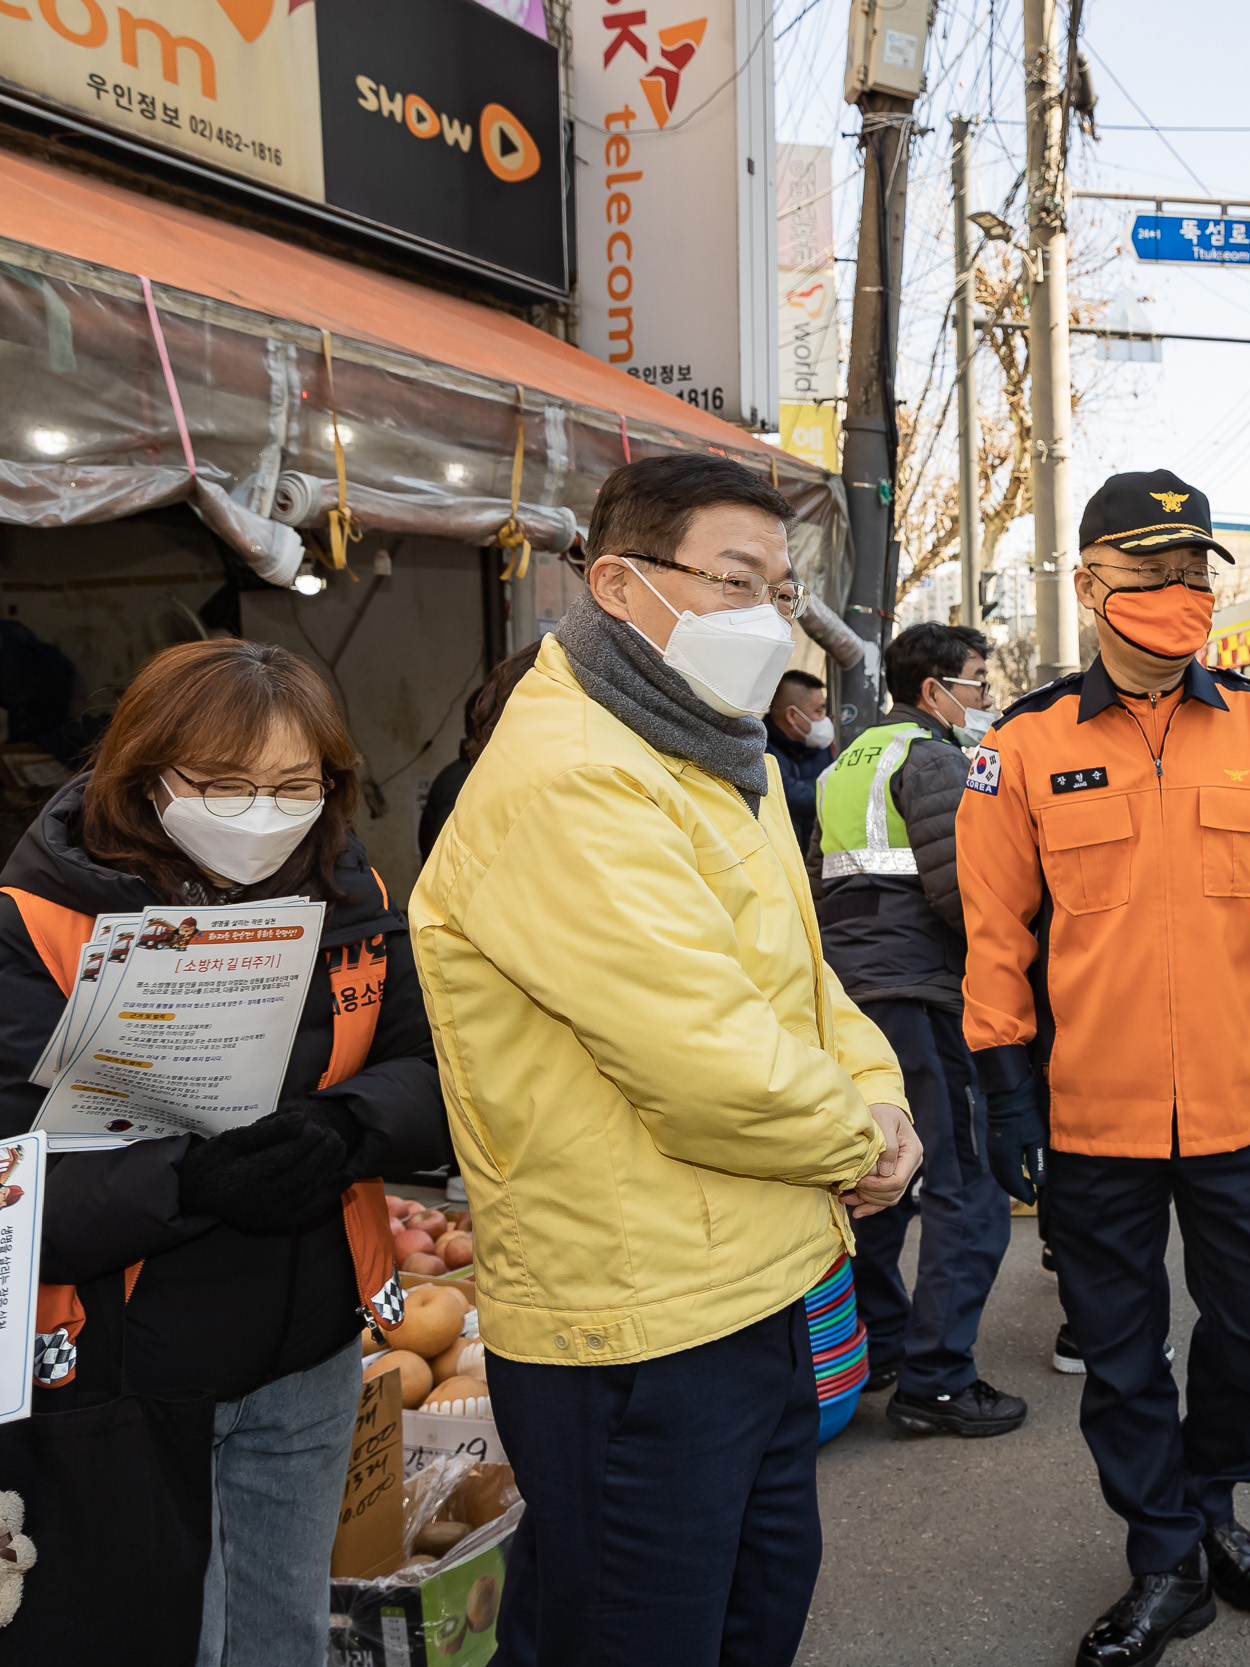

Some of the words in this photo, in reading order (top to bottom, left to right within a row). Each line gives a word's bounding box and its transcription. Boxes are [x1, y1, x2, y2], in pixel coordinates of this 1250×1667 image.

[602, 0, 648, 70] K
[86, 72, 182, 129] 우인정보
[188, 115, 283, 166] 02)462-1816
[355, 74, 472, 153] SHOW
[604, 103, 644, 364] telecom
[793, 320, 818, 393] world
[966, 778, 992, 793] KOREA
[211, 920, 230, 928] 생명을
[183, 958, 224, 973] 소방차
[227, 958, 238, 971] 길
[241, 954, 275, 970] 터주기
[0, 1225, 14, 1254] 생명을
